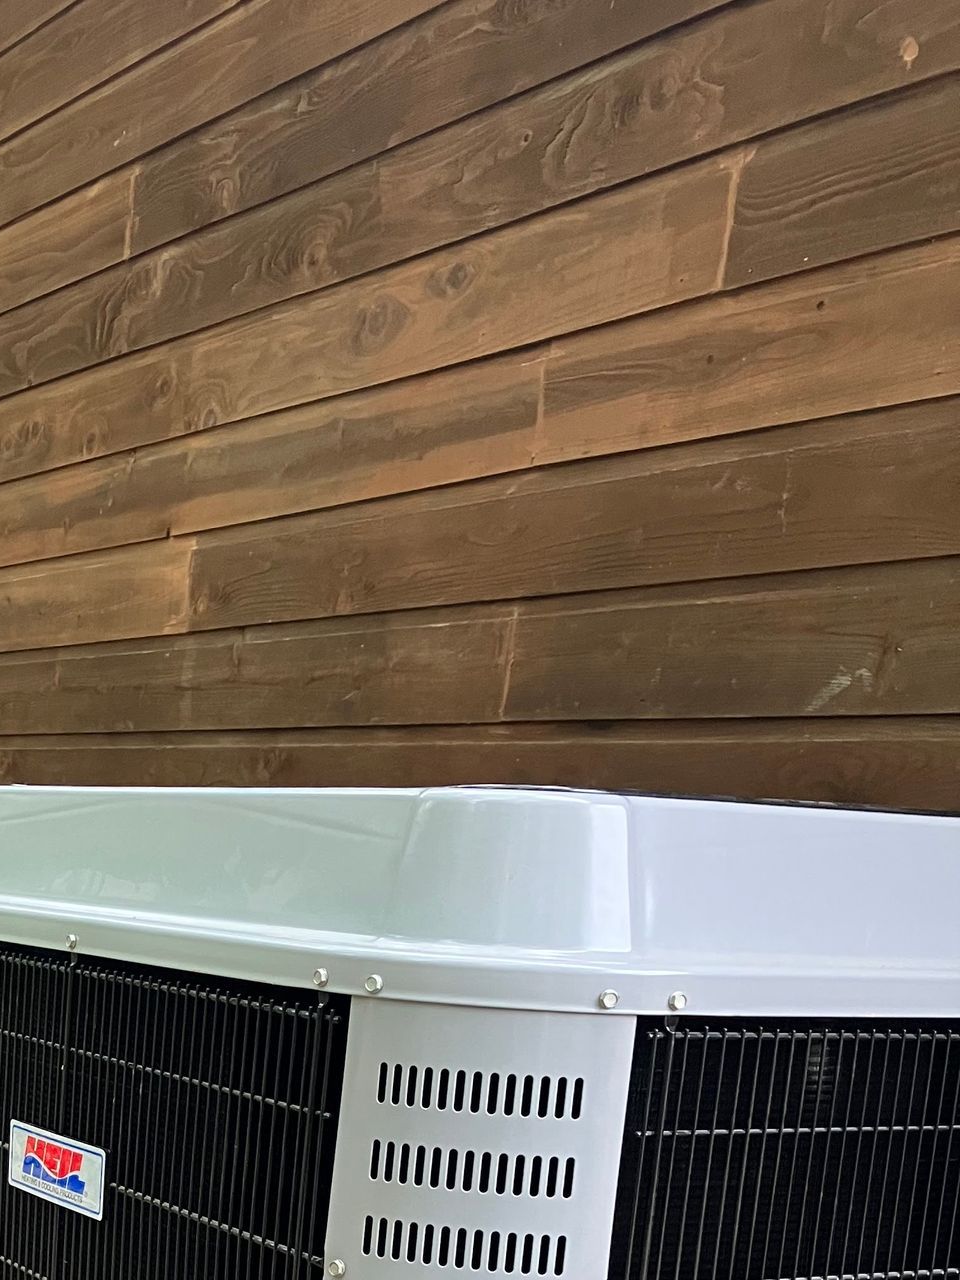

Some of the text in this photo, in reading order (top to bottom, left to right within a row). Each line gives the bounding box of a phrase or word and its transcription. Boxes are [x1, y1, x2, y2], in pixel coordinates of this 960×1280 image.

[23, 1135, 86, 1195] HEIL
[41, 1182, 59, 1194] COOLING
[59, 1189, 83, 1203] PRODUCTS
